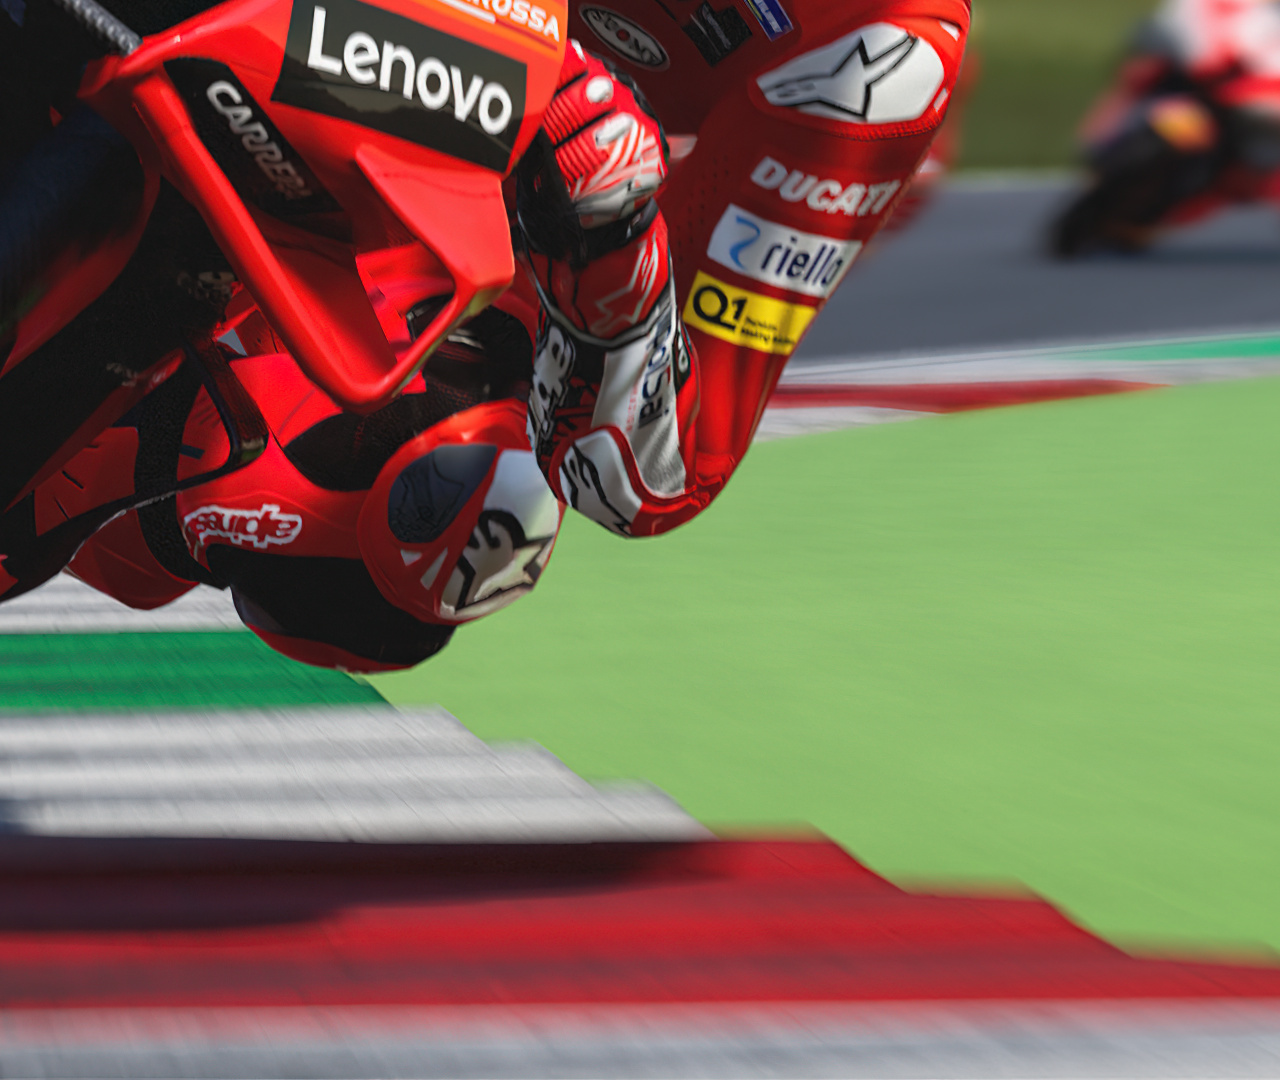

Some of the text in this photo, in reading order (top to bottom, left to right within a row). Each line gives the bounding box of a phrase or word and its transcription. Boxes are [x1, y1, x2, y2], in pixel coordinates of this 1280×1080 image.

[307, 6, 512, 135] Lenovo
[750, 155, 901, 217] DUCATI
[760, 235, 844, 287] riello
